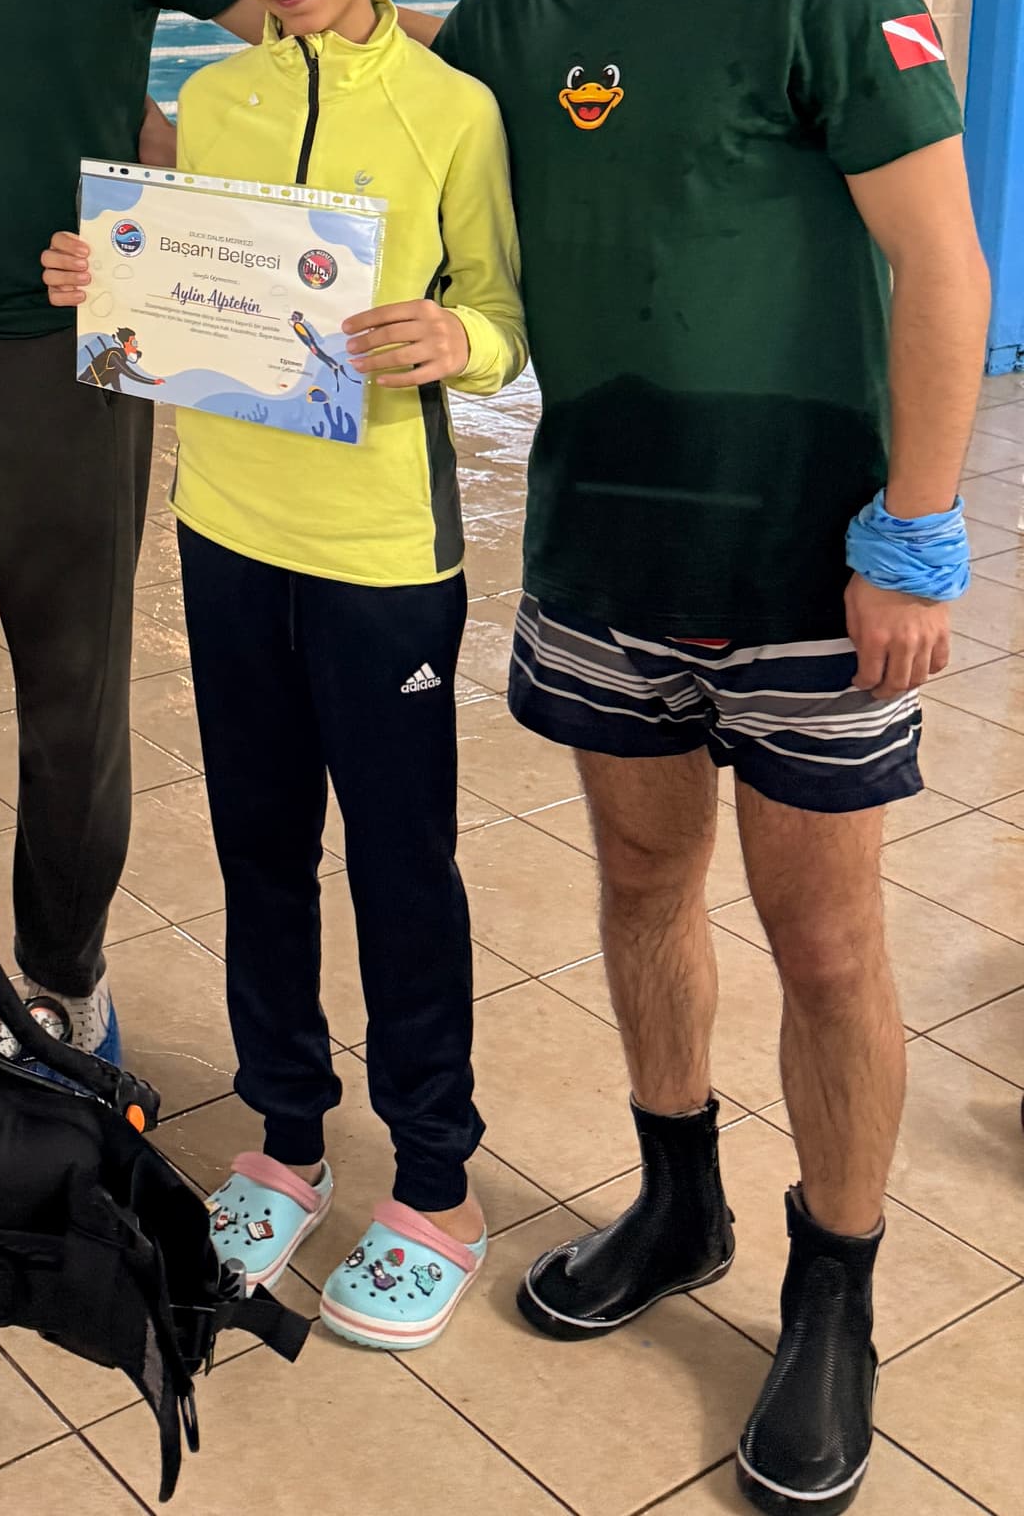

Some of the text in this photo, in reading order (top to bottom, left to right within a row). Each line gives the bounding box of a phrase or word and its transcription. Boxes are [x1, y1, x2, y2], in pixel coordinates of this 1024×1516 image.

[160, 236, 214, 259] Başarı
[218, 246, 281, 270] Belgesi
[171, 282, 261, 313] Aylin Alptekin
[400, 676, 442, 694] adidas
